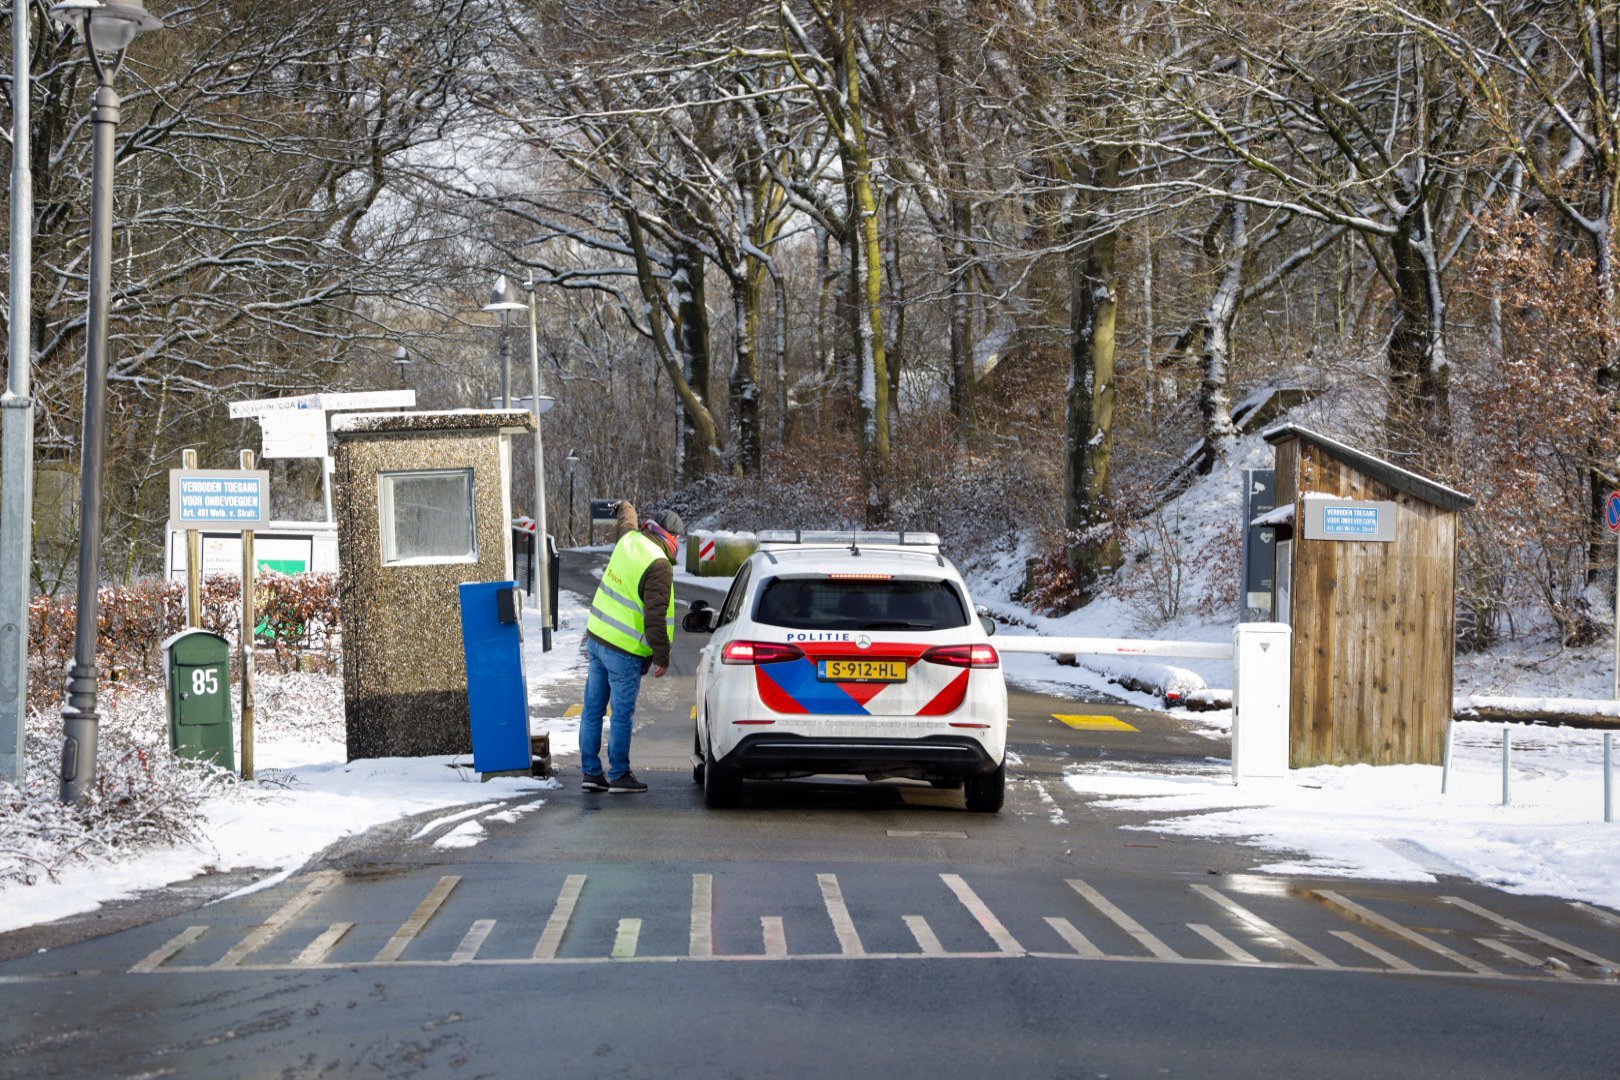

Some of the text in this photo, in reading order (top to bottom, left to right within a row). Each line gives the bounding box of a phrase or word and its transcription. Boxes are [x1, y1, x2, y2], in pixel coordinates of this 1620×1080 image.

[182, 481, 258, 493] VERBODEN TOEGANG
[182, 495, 258, 507] VOOR ONBEVOEGDEN
[183, 508, 195, 517] Art.
[197, 508, 208, 517] 461
[787, 633, 850, 641] POLITIE
[832, 662, 898, 677] S-912-HL
[192, 668, 218, 695] 85
